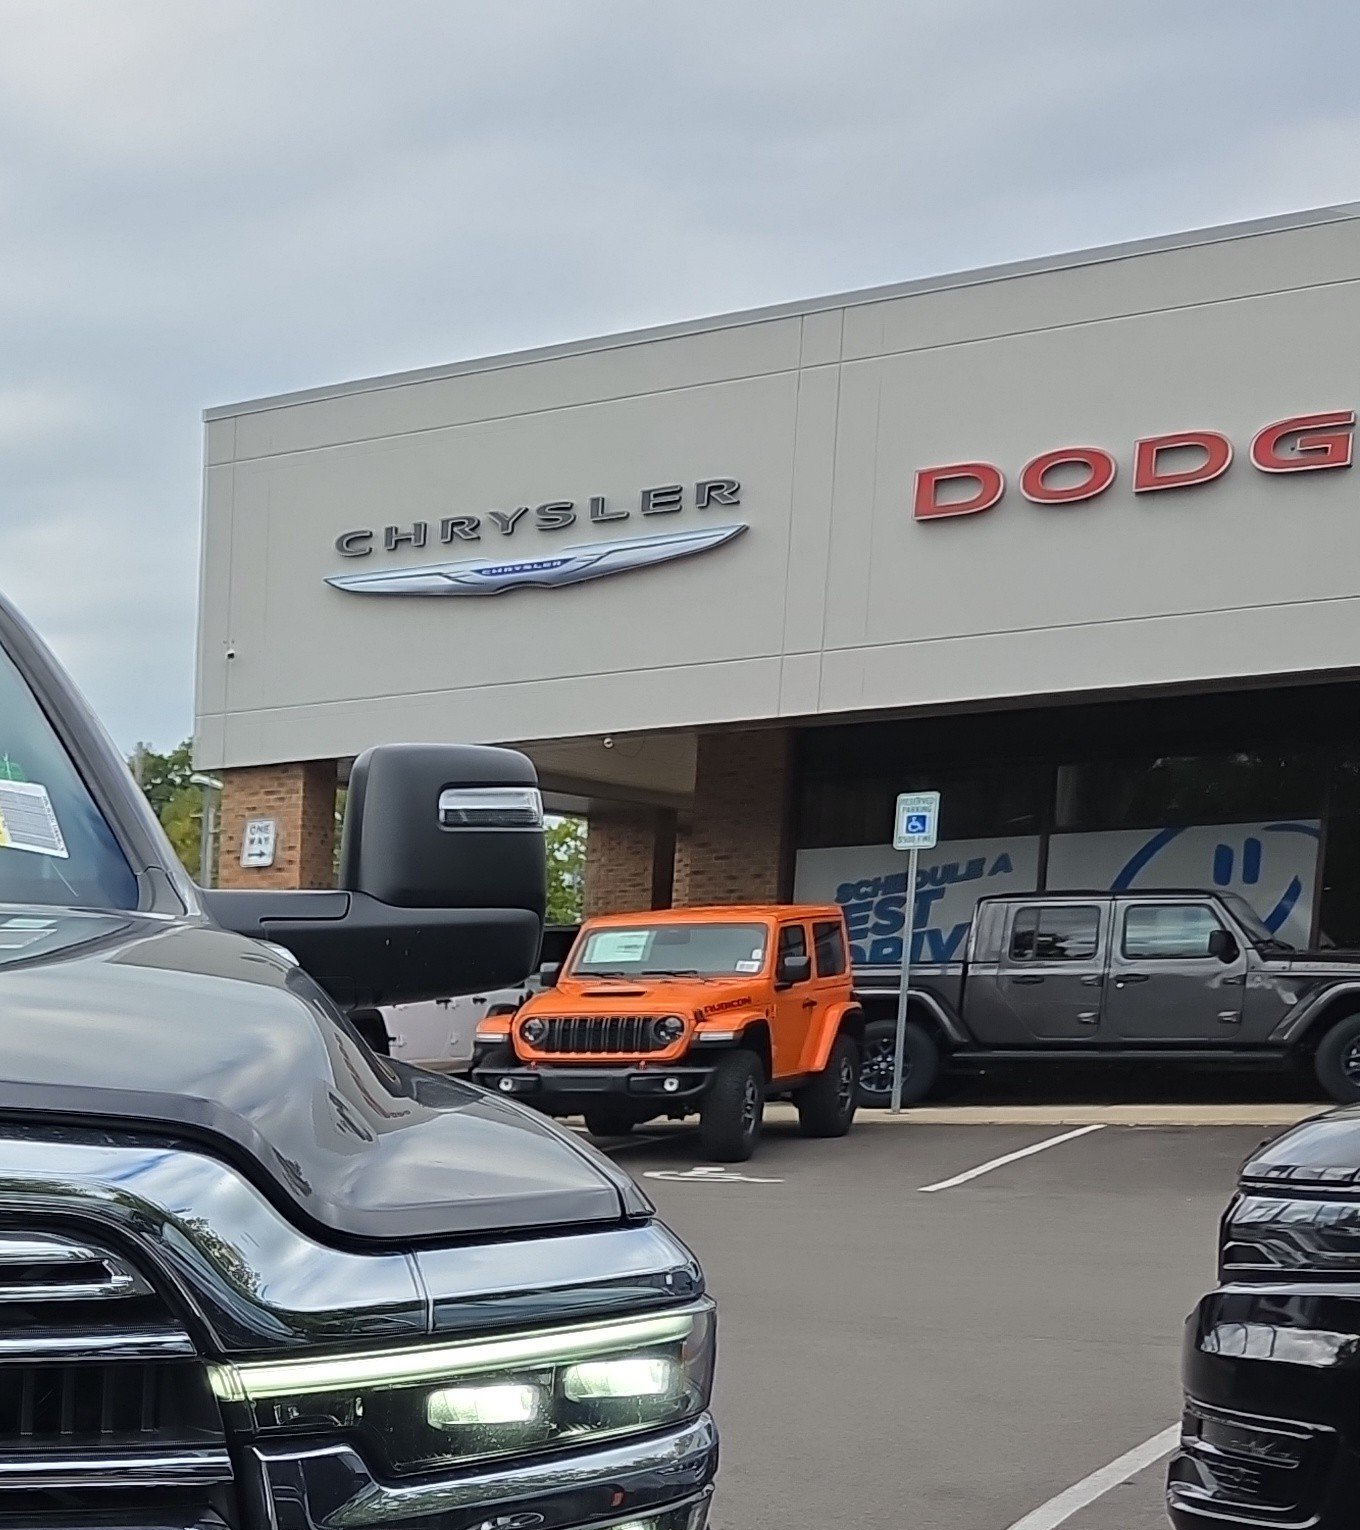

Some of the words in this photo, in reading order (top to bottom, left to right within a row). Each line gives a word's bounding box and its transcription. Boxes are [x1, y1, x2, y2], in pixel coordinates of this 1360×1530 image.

[913, 409, 1357, 520] DODG
[334, 477, 741, 557] CHRYSLER
[481, 558, 562, 576] CHRYSLER
[248, 834, 271, 846] WAY
[249, 822, 272, 834] ONE
[835, 857, 986, 903] SCHEDULE
[988, 853, 1013, 876] A
[843, 887, 946, 941] EST
[850, 922, 972, 963] RIV
[704, 996, 752, 1014] RUBICON
